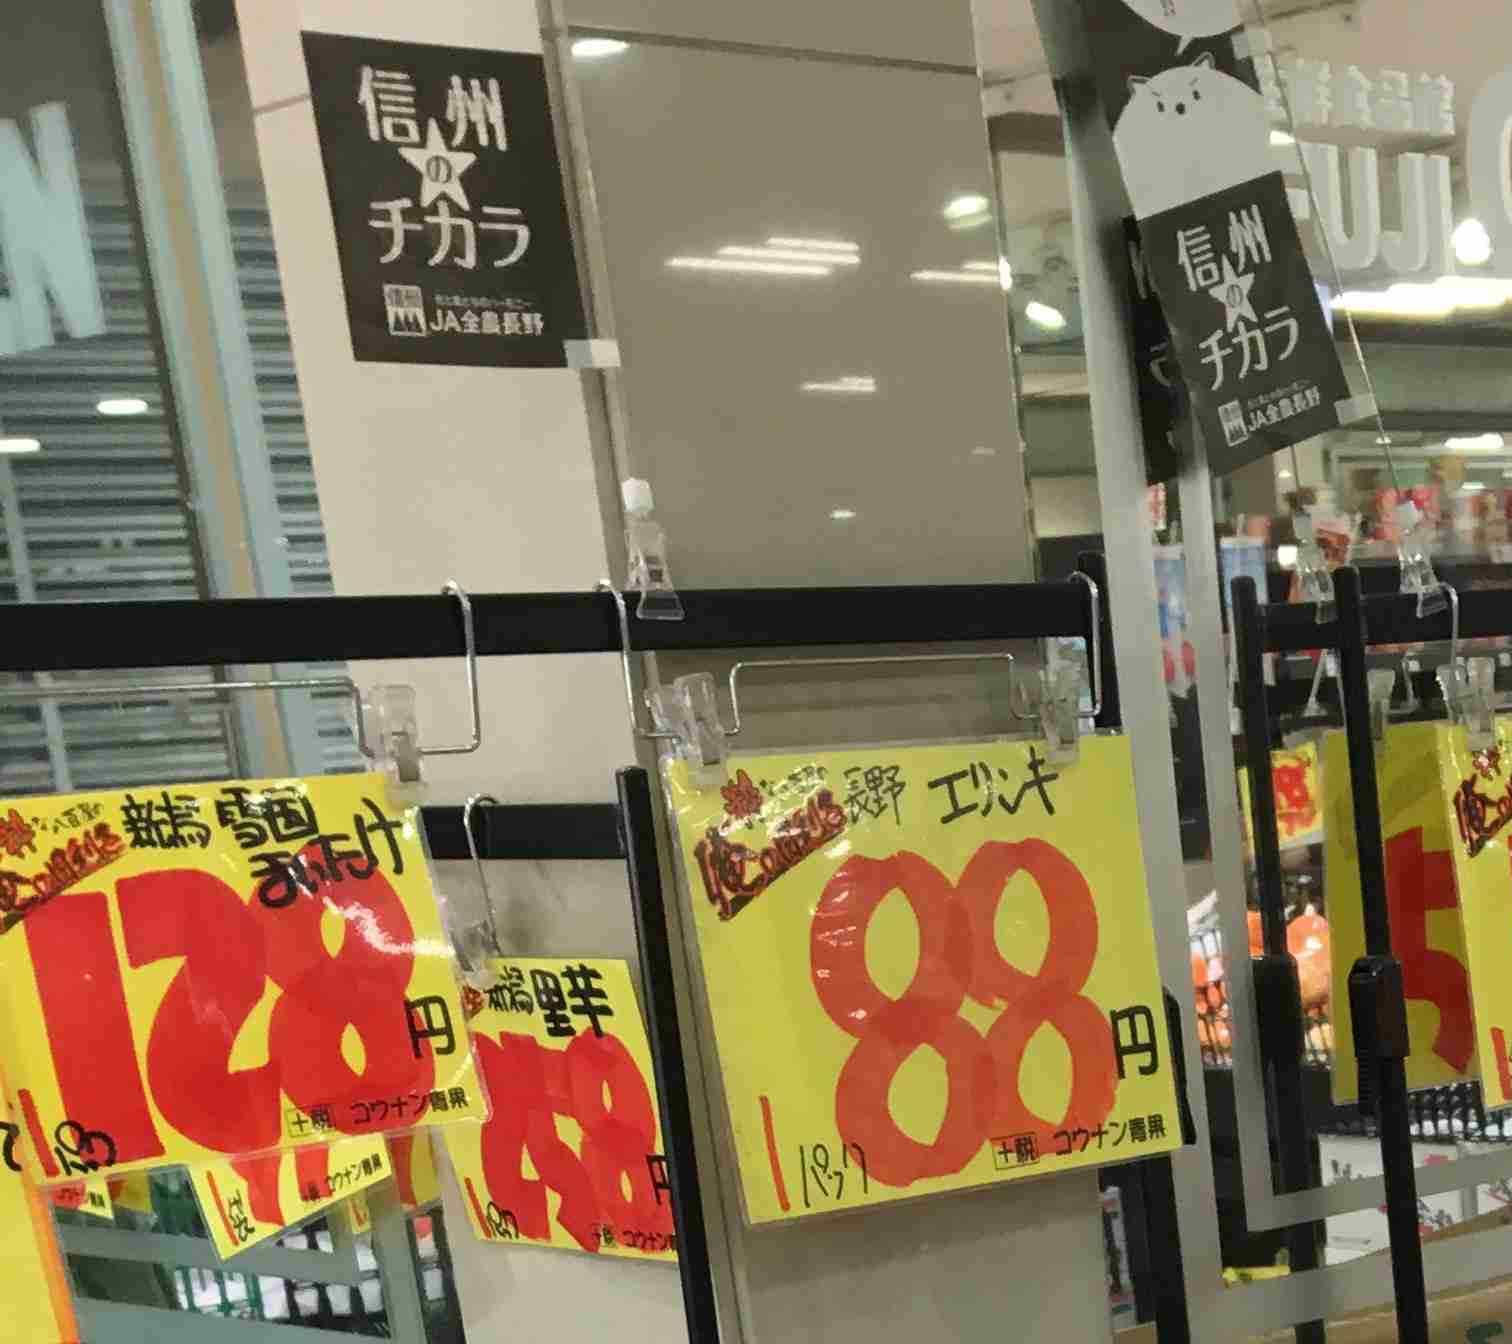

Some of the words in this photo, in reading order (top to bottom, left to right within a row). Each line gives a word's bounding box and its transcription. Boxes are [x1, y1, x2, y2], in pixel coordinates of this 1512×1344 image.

[357, 65, 507, 151] 信州
[424, 154, 452, 185] の
[368, 197, 531, 270] チカラ
[1177, 204, 1272, 292] 信州
[430, 310, 544, 337] JA全農長野
[1199, 306, 1299, 391] チカラ
[844, 765, 905, 824] 長野
[405, 995, 456, 1058] 円
[810, 838, 1119, 1189] 88
[1110, 1006, 1159, 1078] 円
[1053, 1114, 1167, 1155] コウナン青果
